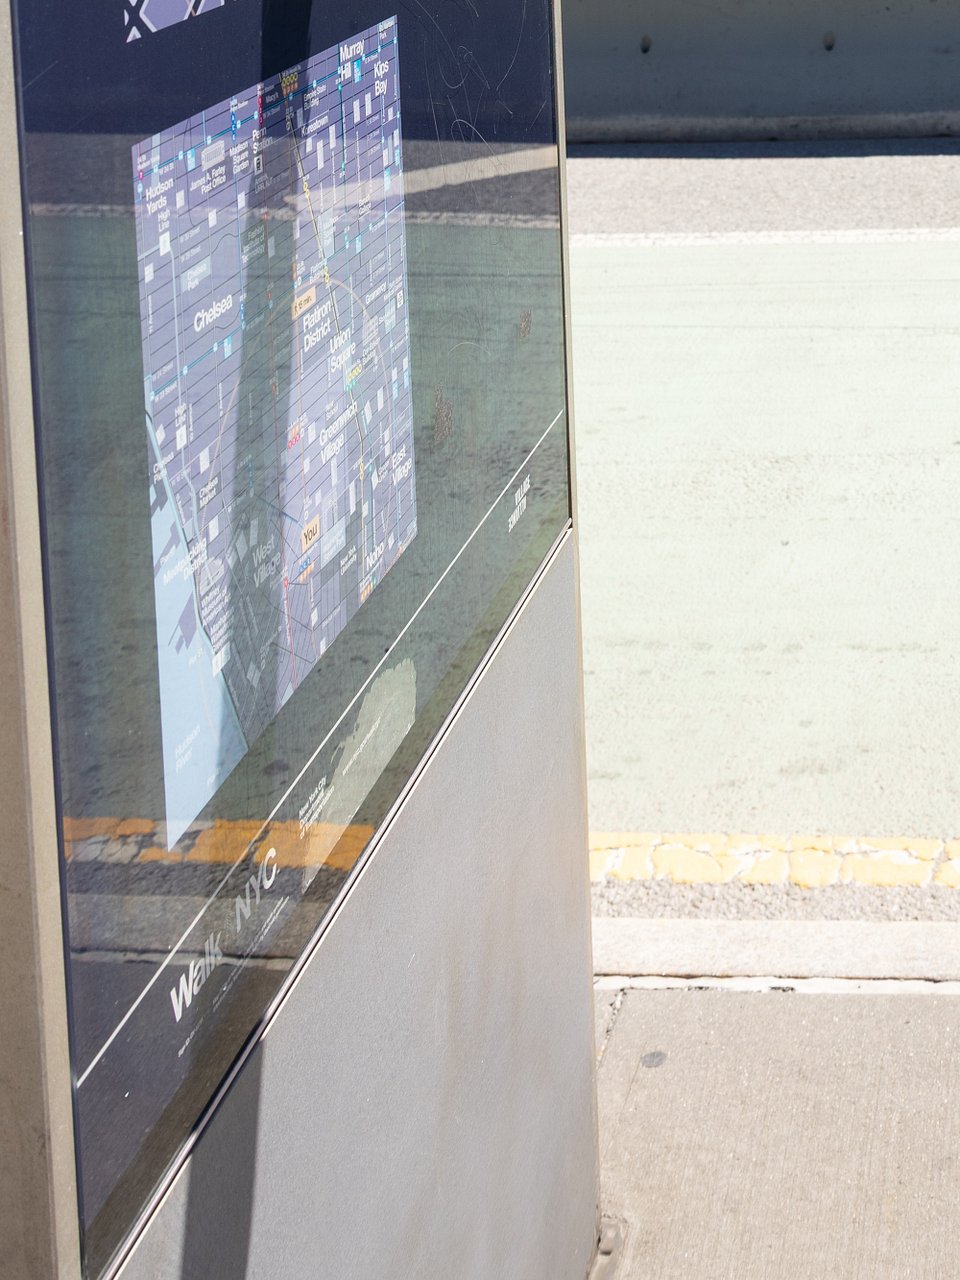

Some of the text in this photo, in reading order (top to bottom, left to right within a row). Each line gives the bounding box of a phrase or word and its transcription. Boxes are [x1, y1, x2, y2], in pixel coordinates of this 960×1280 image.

[339, 39, 365, 63] Murray
[341, 61, 352, 82] Hill
[373, 60, 389, 78] Kips
[374, 79, 388, 97] Bay
[252, 127, 267, 142] Penn
[252, 136, 274, 154] Station
[229, 141, 249, 157] Madison
[232, 151, 249, 166] Square
[189, 178, 207, 192] James
[211, 165, 226, 180] Farley
[232, 159, 250, 174] Garden
[145, 177, 174, 201] Hudson
[211, 175, 227, 189] Office
[146, 195, 168, 215] Yards
[157, 208, 171, 224] High
[158, 220, 170, 232] Line
[193, 293, 233, 333] Chelsea
[302, 299, 332, 333] Flatiron
[303, 319, 331, 353] District
[329, 327, 351, 354] Union
[330, 341, 357, 374] Square
[319, 401, 358, 447] Greenwich
[320, 433, 345, 465] Village
[392, 444, 407, 469] East
[392, 457, 412, 486] Village
[199, 476, 219, 498] Chelsea
[303, 523, 318, 547] You
[251, 534, 275, 566] West
[366, 541, 384, 571] Noho
[253, 551, 282, 588] Village
[170, 931, 224, 1023] Walk
